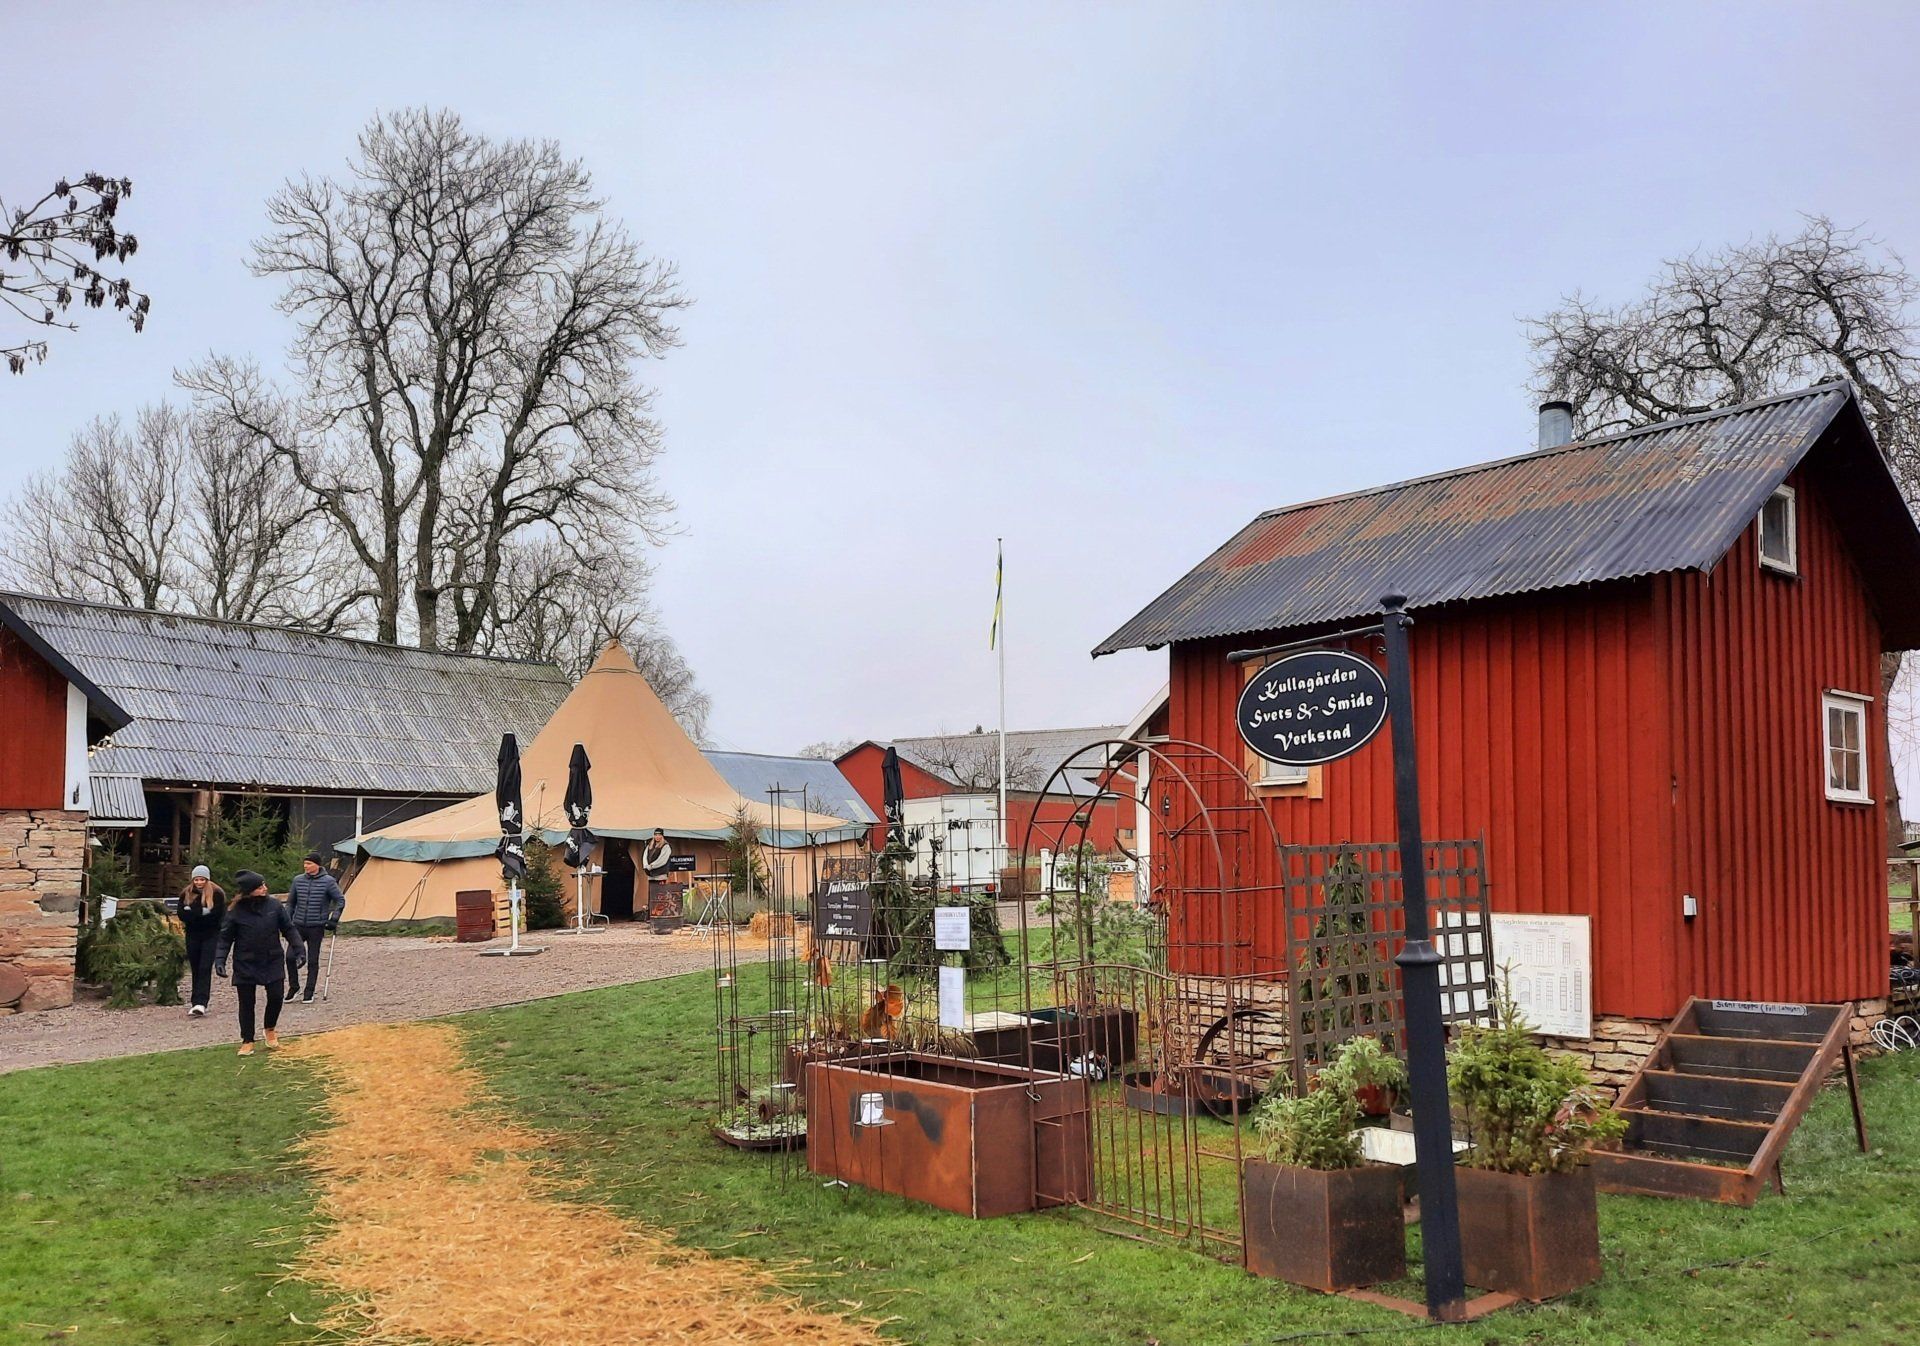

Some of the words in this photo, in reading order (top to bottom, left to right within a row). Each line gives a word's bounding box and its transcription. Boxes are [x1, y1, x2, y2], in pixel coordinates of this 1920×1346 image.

[1258, 668, 1358, 701] Kullagården
[1249, 707, 1293, 728] Svets
[1296, 702, 1319, 720] &
[1321, 692, 1374, 716] Smide
[1273, 723, 1352, 752] Verkstad
